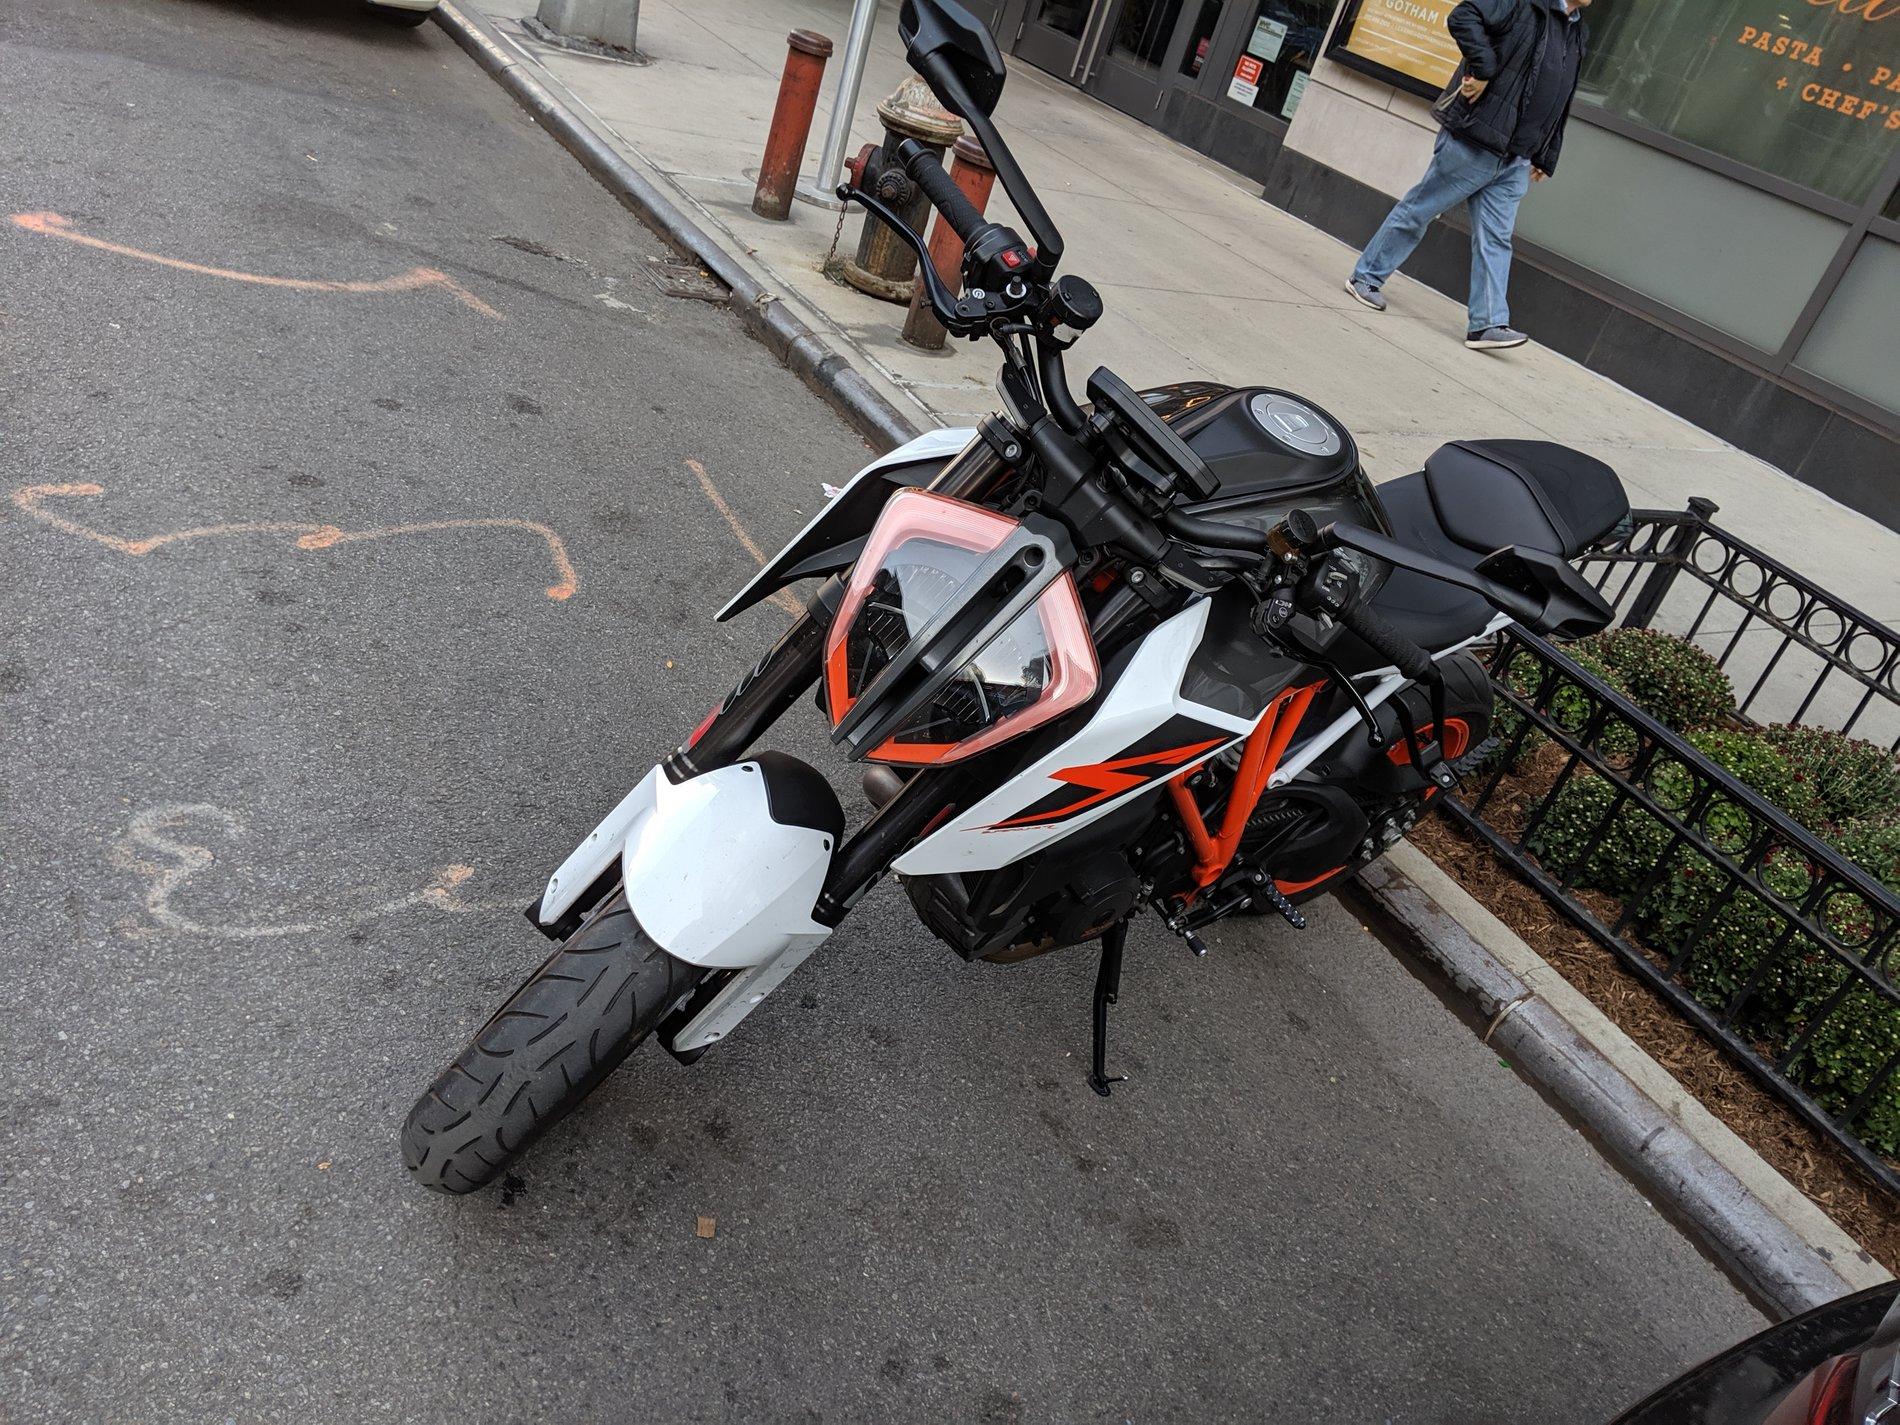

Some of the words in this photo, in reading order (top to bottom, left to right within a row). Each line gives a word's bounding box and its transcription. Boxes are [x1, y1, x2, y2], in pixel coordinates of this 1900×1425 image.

[1385, 0, 1439, 25] GOTHAM
[1738, 25, 1824, 67] PASTA
[1801, 83, 1900, 129] CHEF'S
